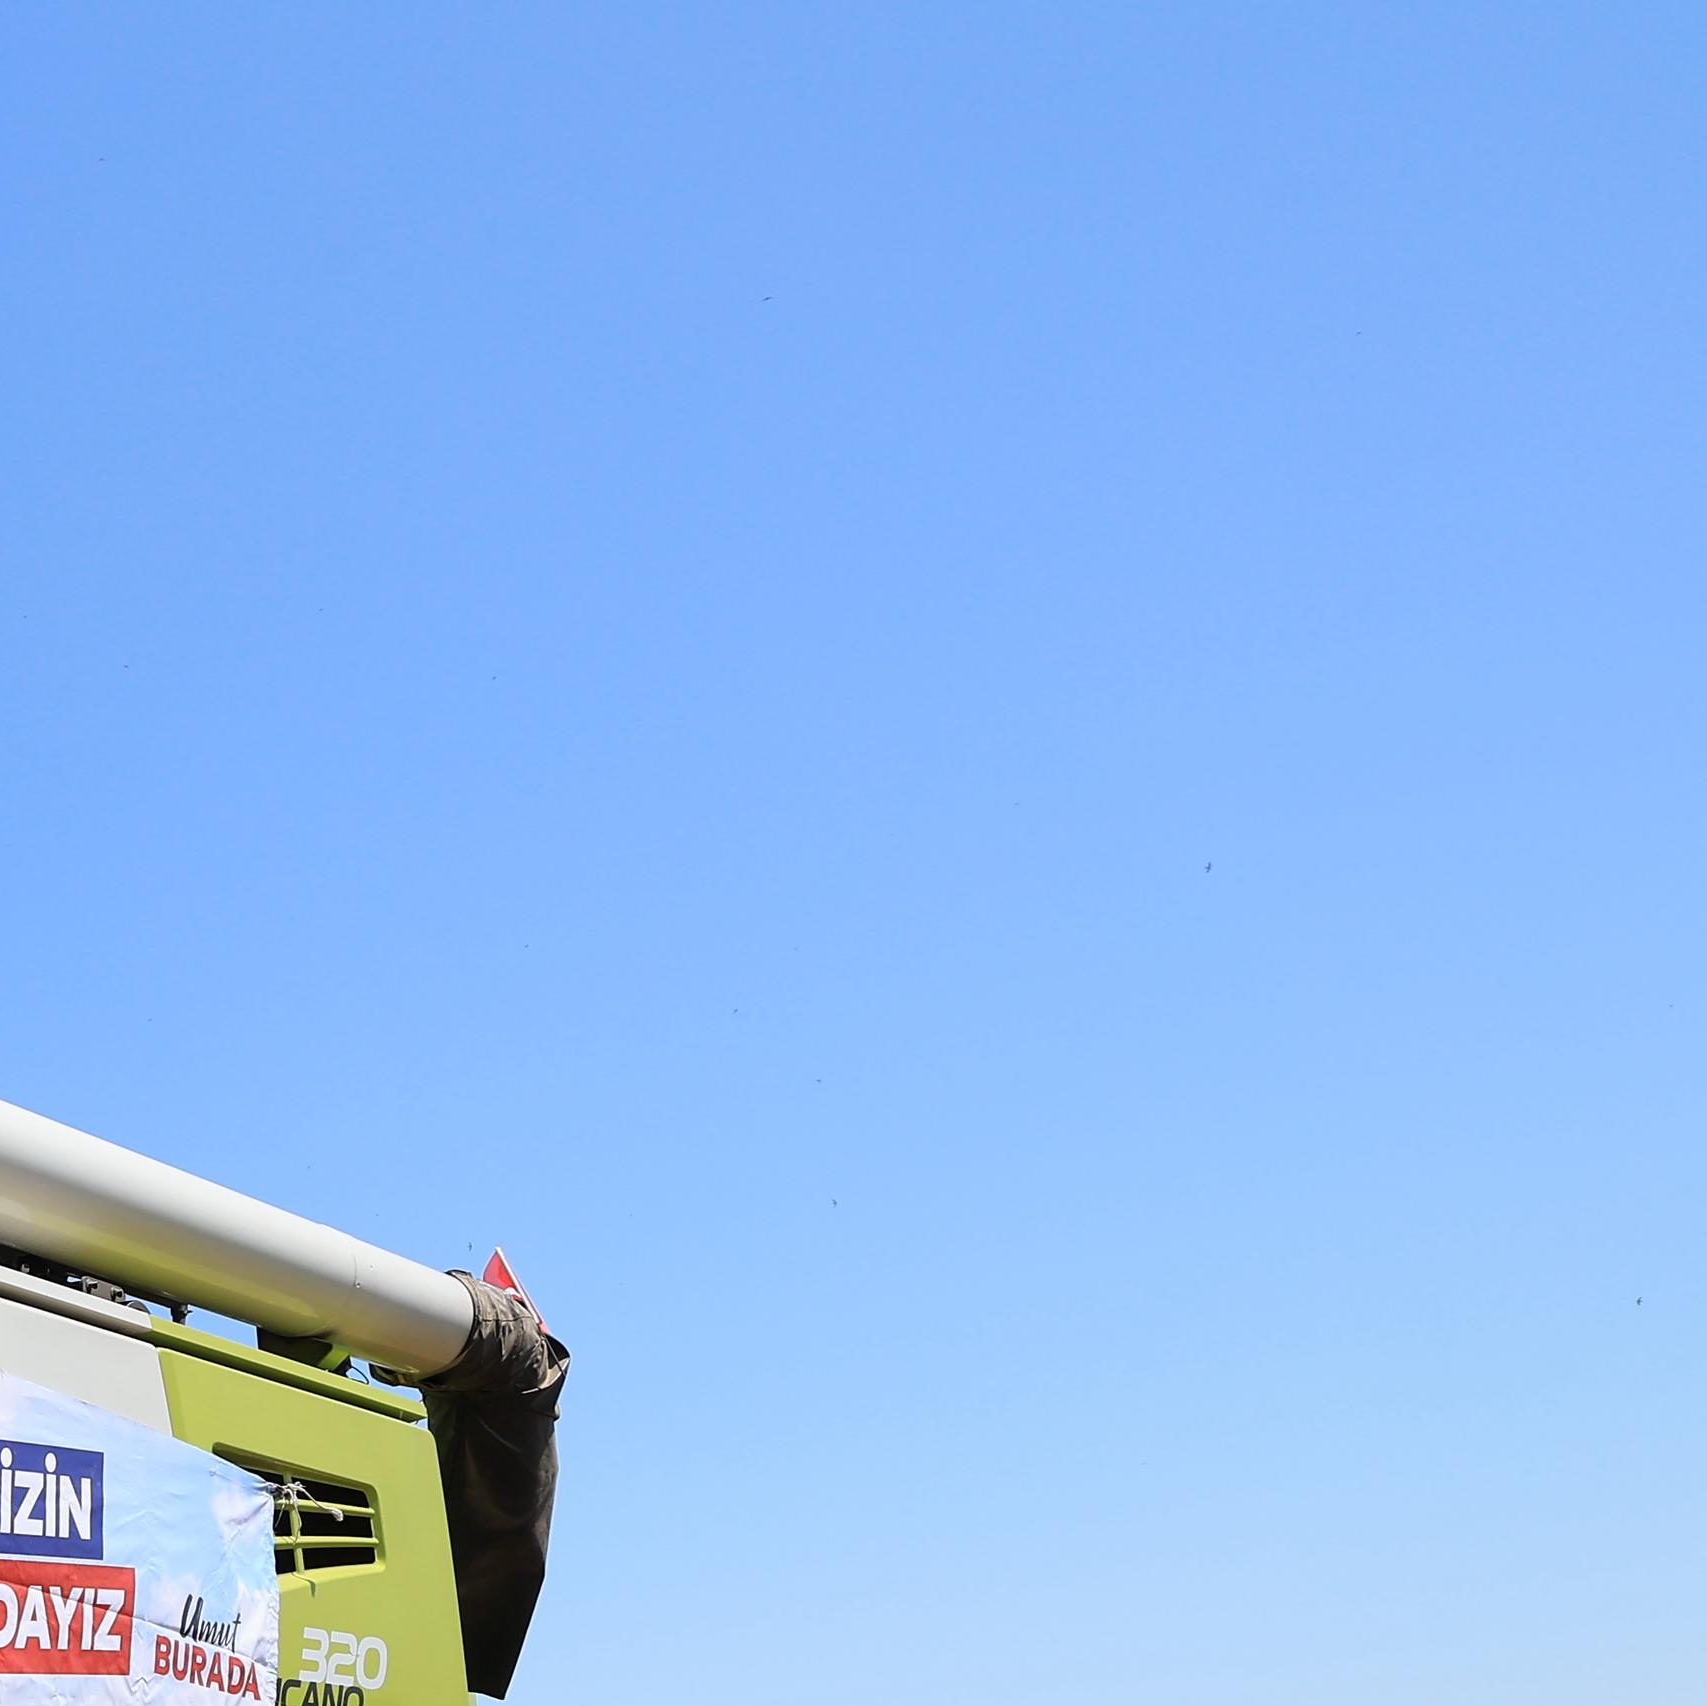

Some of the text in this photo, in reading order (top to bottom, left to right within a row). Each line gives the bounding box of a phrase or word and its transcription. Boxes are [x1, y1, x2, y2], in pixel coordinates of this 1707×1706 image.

[179, 1594, 242, 1653] Umut
[154, 1634, 261, 1700] BURADA
[298, 1627, 388, 1690] 320
